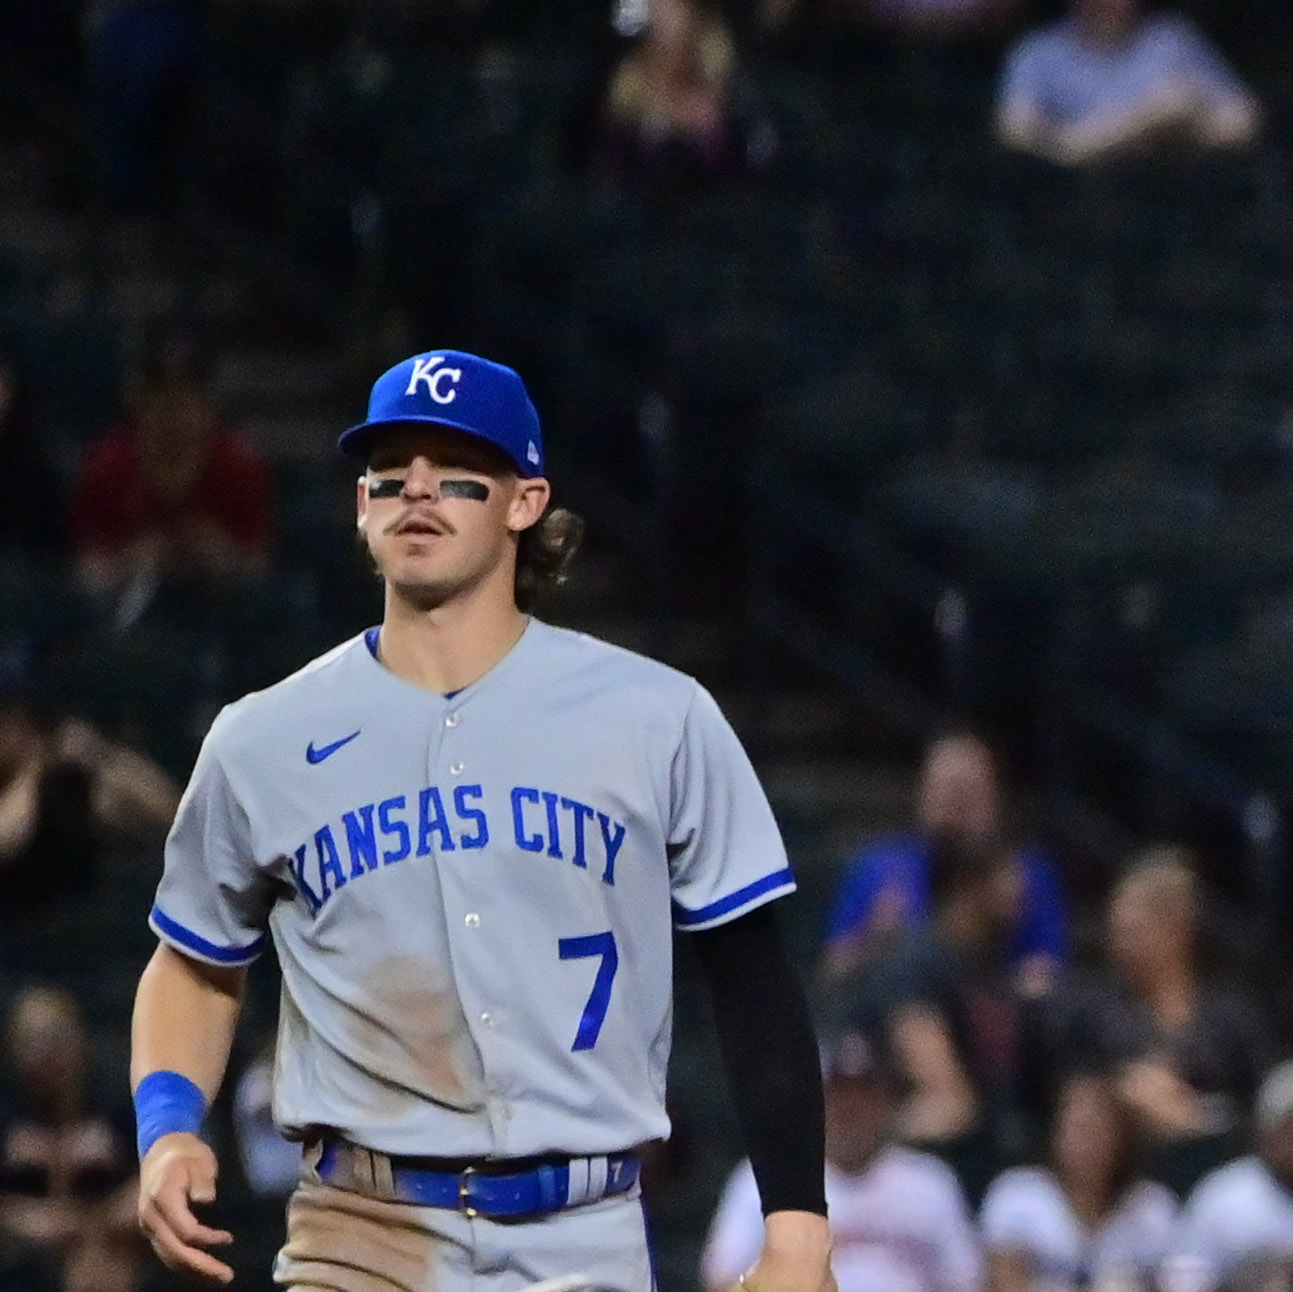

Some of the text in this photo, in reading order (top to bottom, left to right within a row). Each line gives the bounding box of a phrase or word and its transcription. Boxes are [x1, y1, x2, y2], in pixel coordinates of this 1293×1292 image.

[405, 356, 461, 404] KC
[288, 784, 626, 913] KANSAS CITY
[557, 930, 619, 1051] 7
